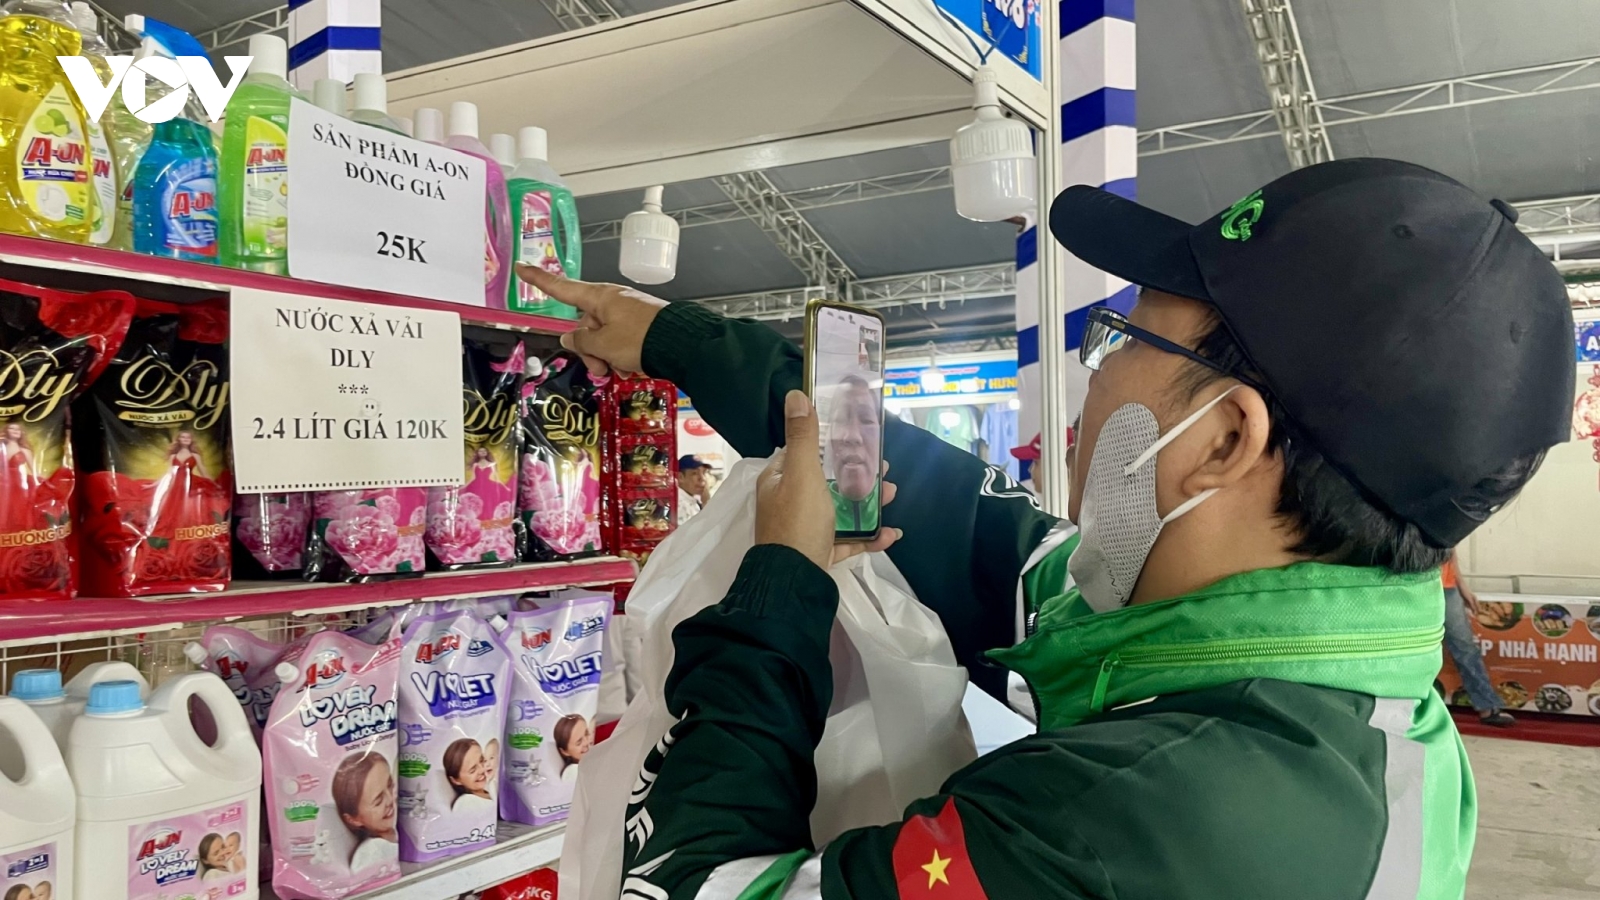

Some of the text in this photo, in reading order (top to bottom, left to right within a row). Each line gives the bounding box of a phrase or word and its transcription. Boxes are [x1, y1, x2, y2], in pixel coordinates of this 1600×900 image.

[313, 122, 470, 181] SẢN PHẨM A-ON
[344, 161, 446, 201] ĐỒNG GIÁ
[376, 231, 428, 264] 25K
[275, 307, 424, 339] NƯỚC XẢ VẢI
[330, 348, 375, 369] DLY
[1586, 335, 1600, 351] A
[115, 354, 230, 430] Dly
[252, 411, 448, 440] 2.4 LÍT GIÁ 120K
[1499, 638, 1539, 659] NHÀ
[1543, 642, 1598, 665] HẠNH
